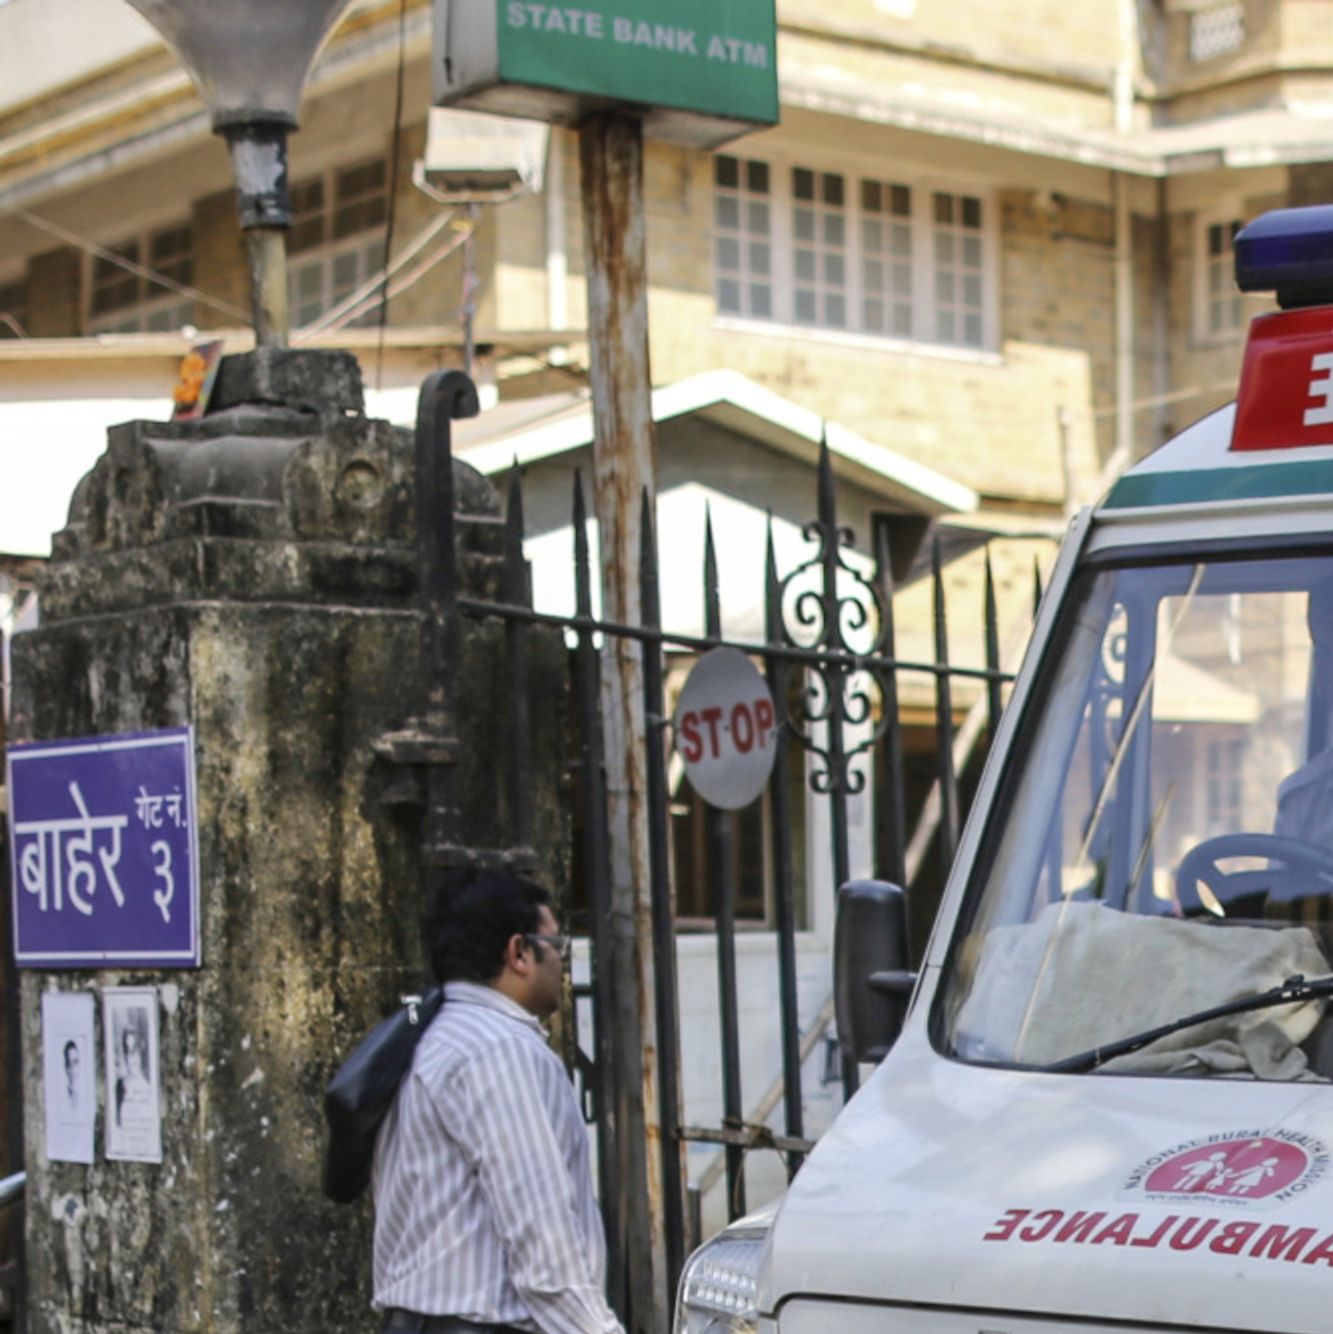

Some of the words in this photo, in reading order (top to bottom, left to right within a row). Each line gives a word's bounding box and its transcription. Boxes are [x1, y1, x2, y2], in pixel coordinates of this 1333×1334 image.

[506, 3, 604, 38] STATE
[613, 17, 698, 55] BANK
[707, 35, 767, 68] ATM
[681, 698, 774, 764] STOP
[134, 785, 163, 830] गेट
[15, 781, 129, 916] बाहेर
[151, 839, 175, 923] ३
[1208, 1128, 1268, 1143] RURAL
[1274, 1128, 1323, 1155] HEALTH
[1123, 1137, 1200, 1191] NATIONAL
[1275, 1153, 1330, 1202] MISSION
